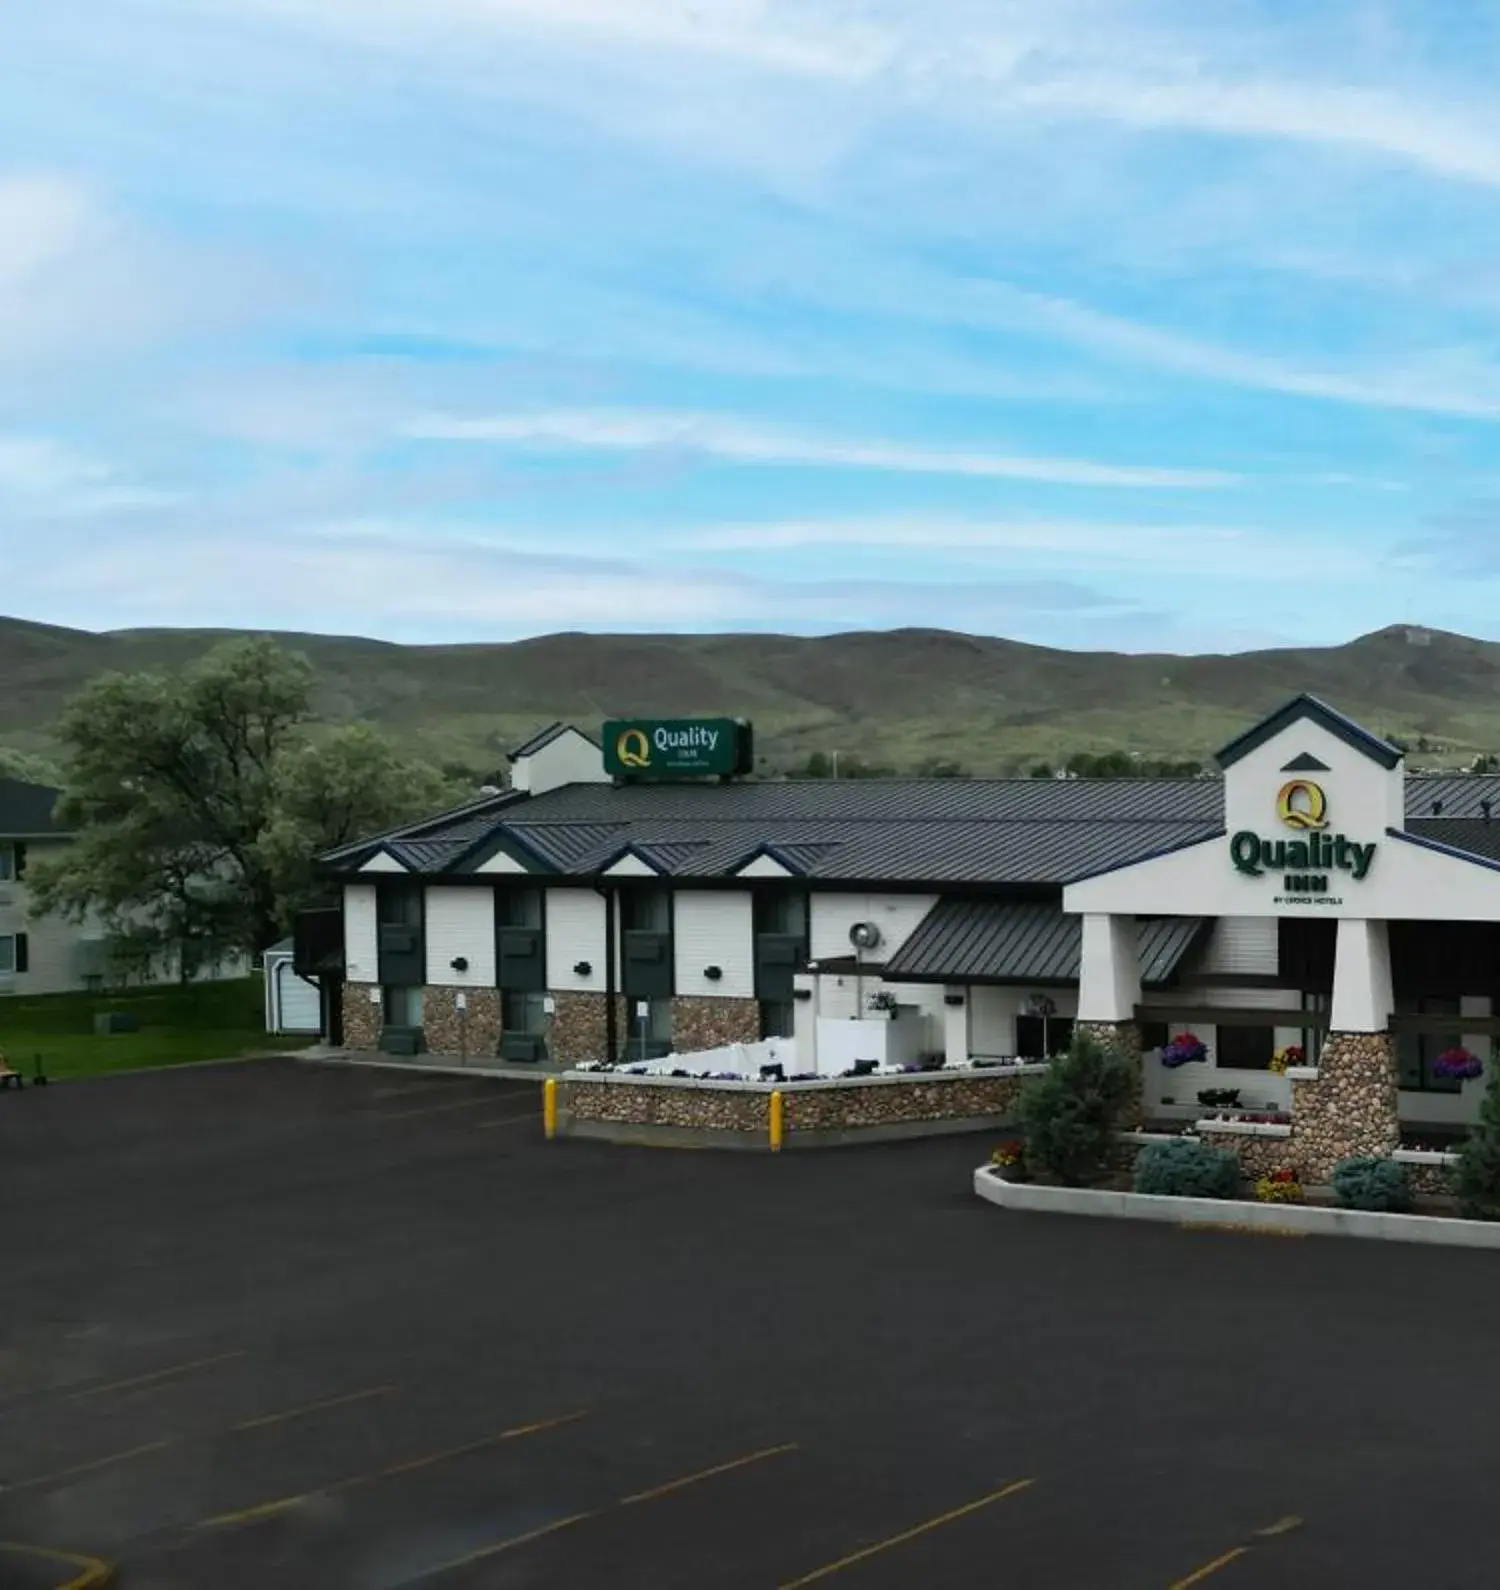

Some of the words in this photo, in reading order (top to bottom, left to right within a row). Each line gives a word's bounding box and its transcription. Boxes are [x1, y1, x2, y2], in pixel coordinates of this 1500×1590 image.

[617, 729, 651, 767] Q
[654, 727, 719, 751] Quality
[1277, 779, 1330, 829] Q
[1230, 831, 1376, 880] Quality
[1284, 875, 1328, 892] INN
